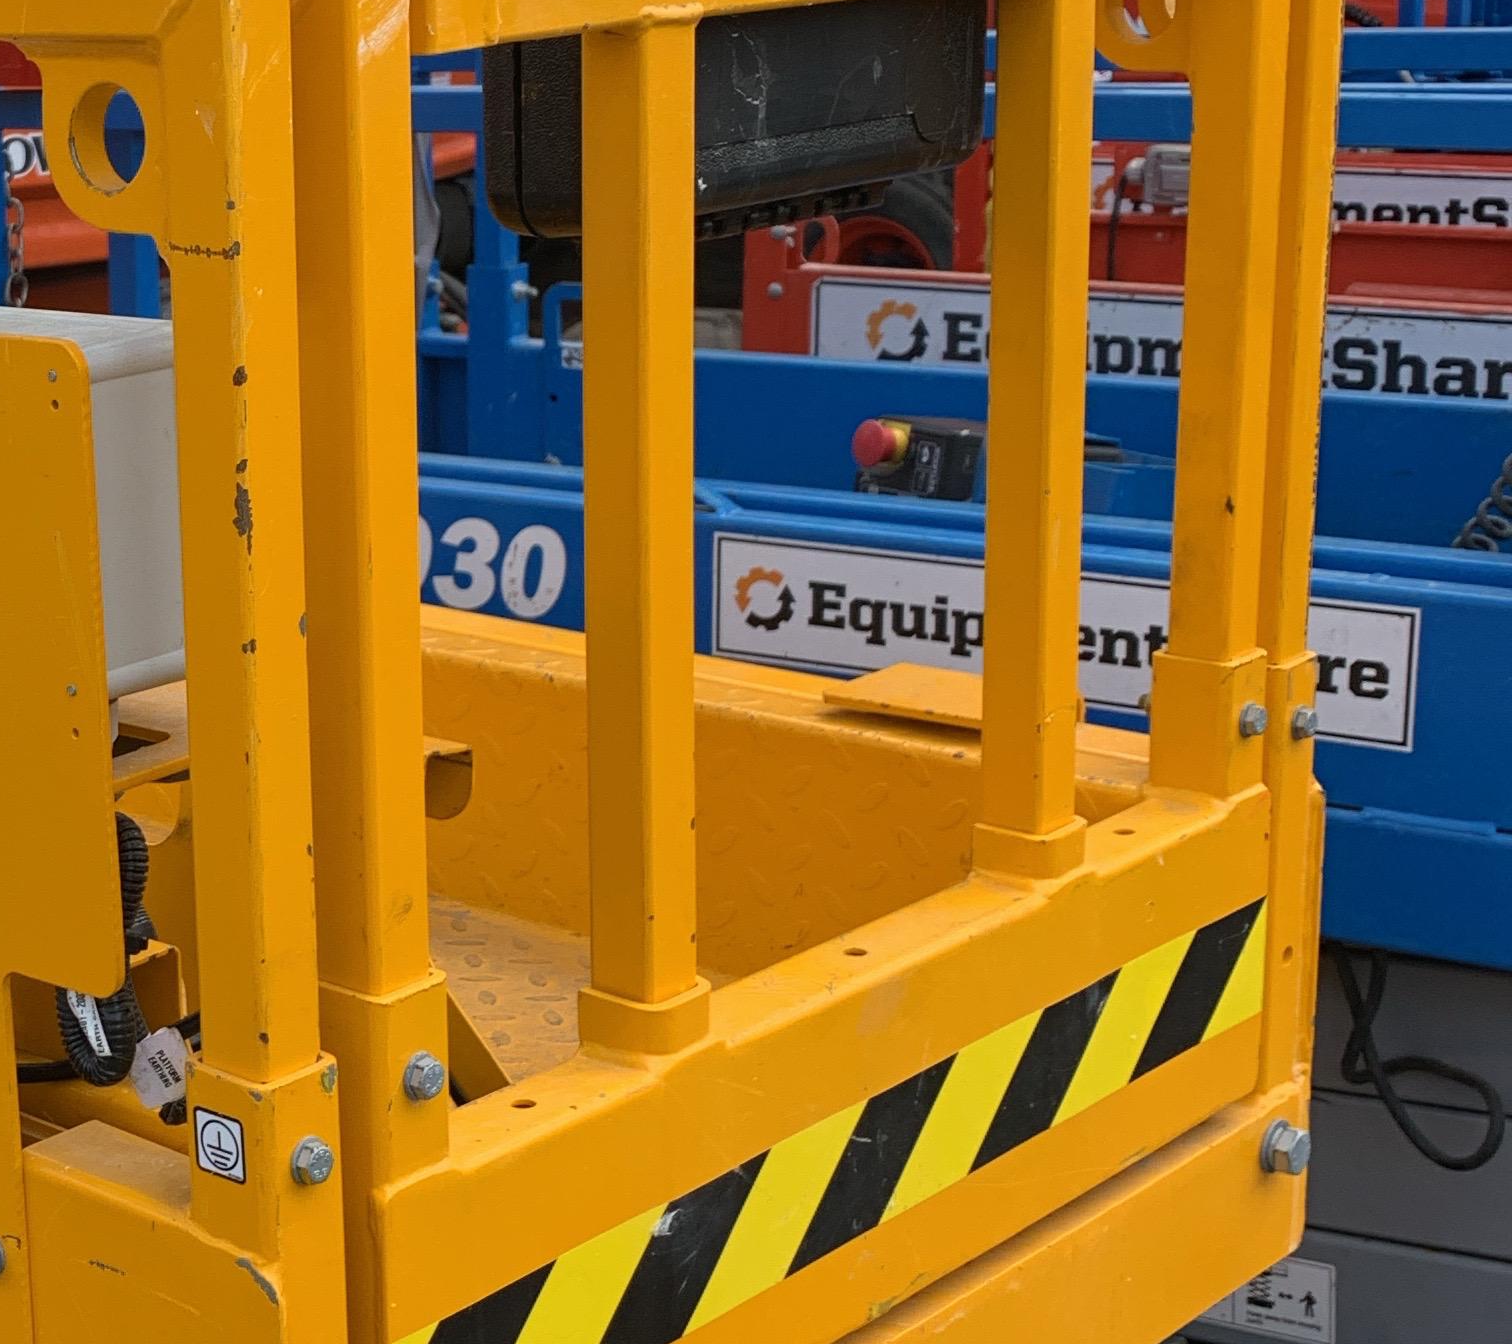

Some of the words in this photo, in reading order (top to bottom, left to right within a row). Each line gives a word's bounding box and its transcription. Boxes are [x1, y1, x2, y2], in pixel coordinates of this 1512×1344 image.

[419, 516, 568, 619] 30
[147, 1055, 173, 1089] EARTHING
[155, 1049, 182, 1085] PLATFORM
